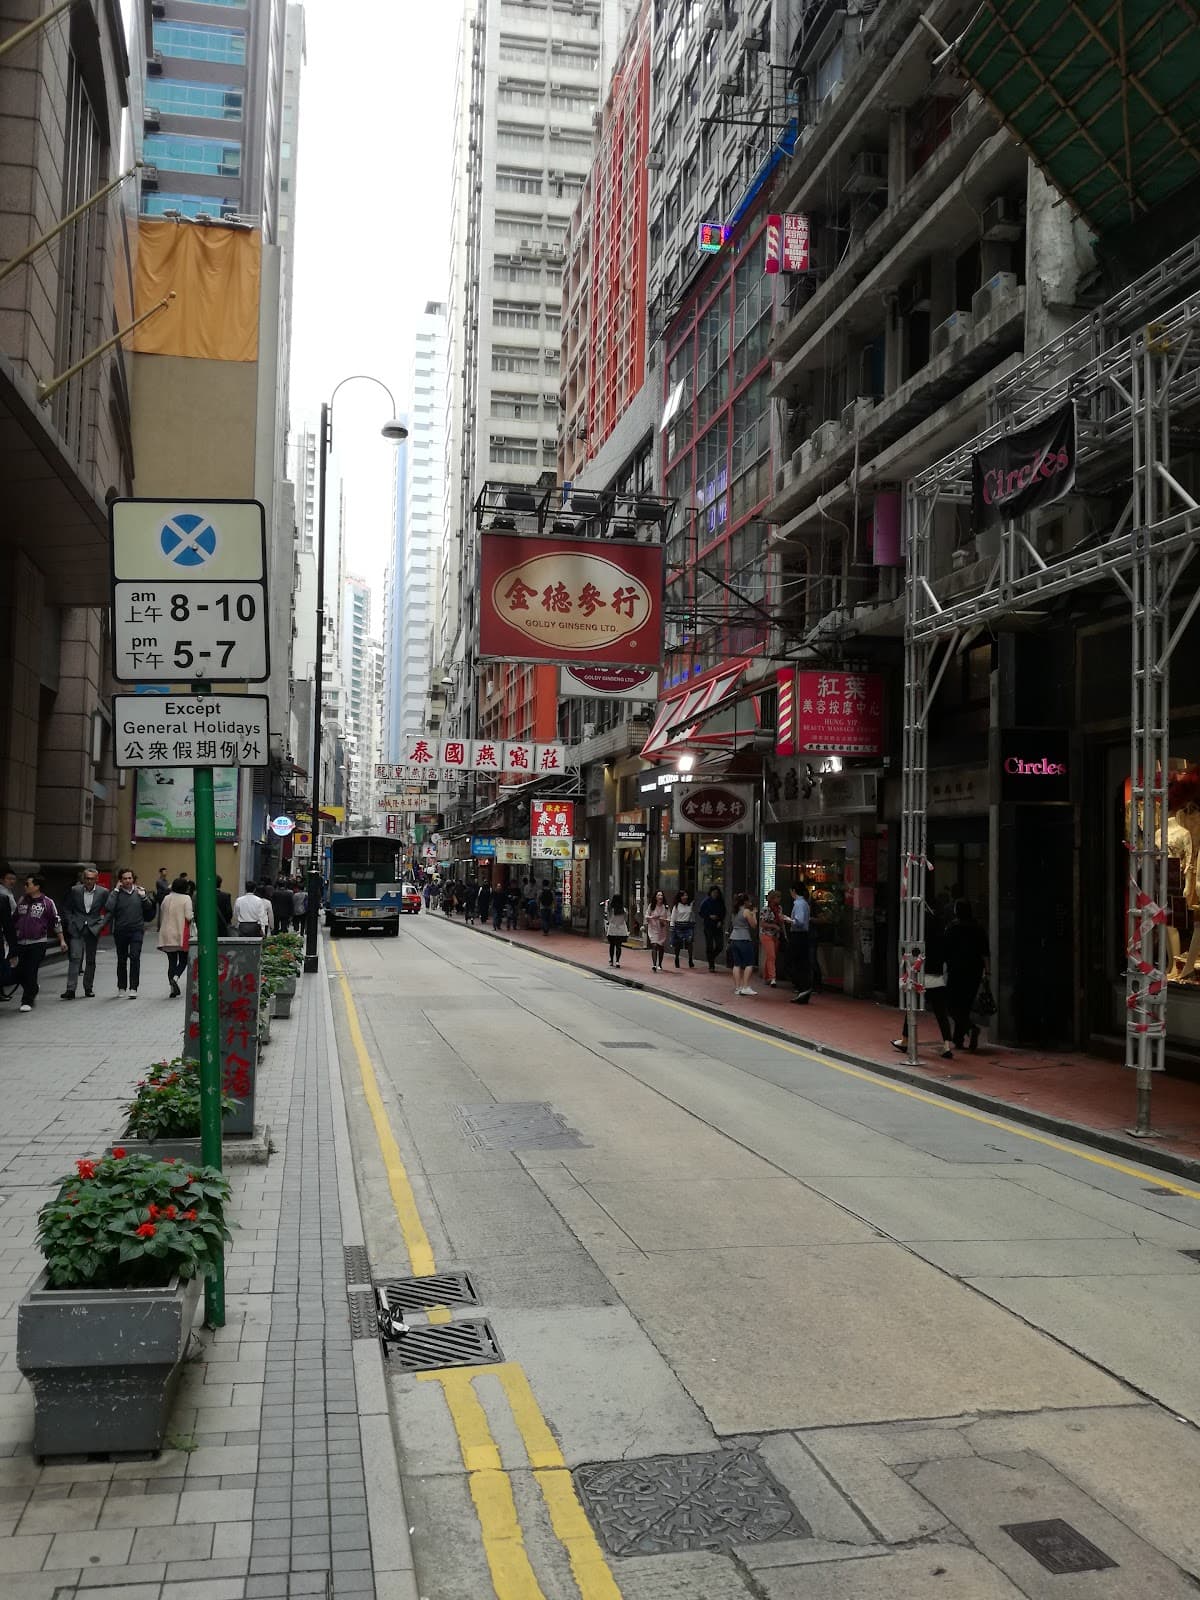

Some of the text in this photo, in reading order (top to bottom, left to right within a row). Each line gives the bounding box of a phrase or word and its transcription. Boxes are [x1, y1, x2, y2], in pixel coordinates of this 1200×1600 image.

[982, 445, 1070, 505] Circles
[131, 592, 156, 602] am
[504, 577, 641, 619] 金德參行
[124, 606, 163, 624] 上午
[525, 619, 619, 633] GOLDY GINSENG LTD.
[131, 636, 158, 651] pm
[125, 652, 164, 670] 下午
[817, 675, 866, 699] 紅葉
[165, 702, 221, 717] Except
[802, 699, 880, 716] 美容按摩中心
[123, 721, 261, 737] General Holidays
[409, 740, 561, 770] 泰國燕窩莊
[1004, 757, 1067, 775] Circles
[685, 801, 744, 816] 金德參行
